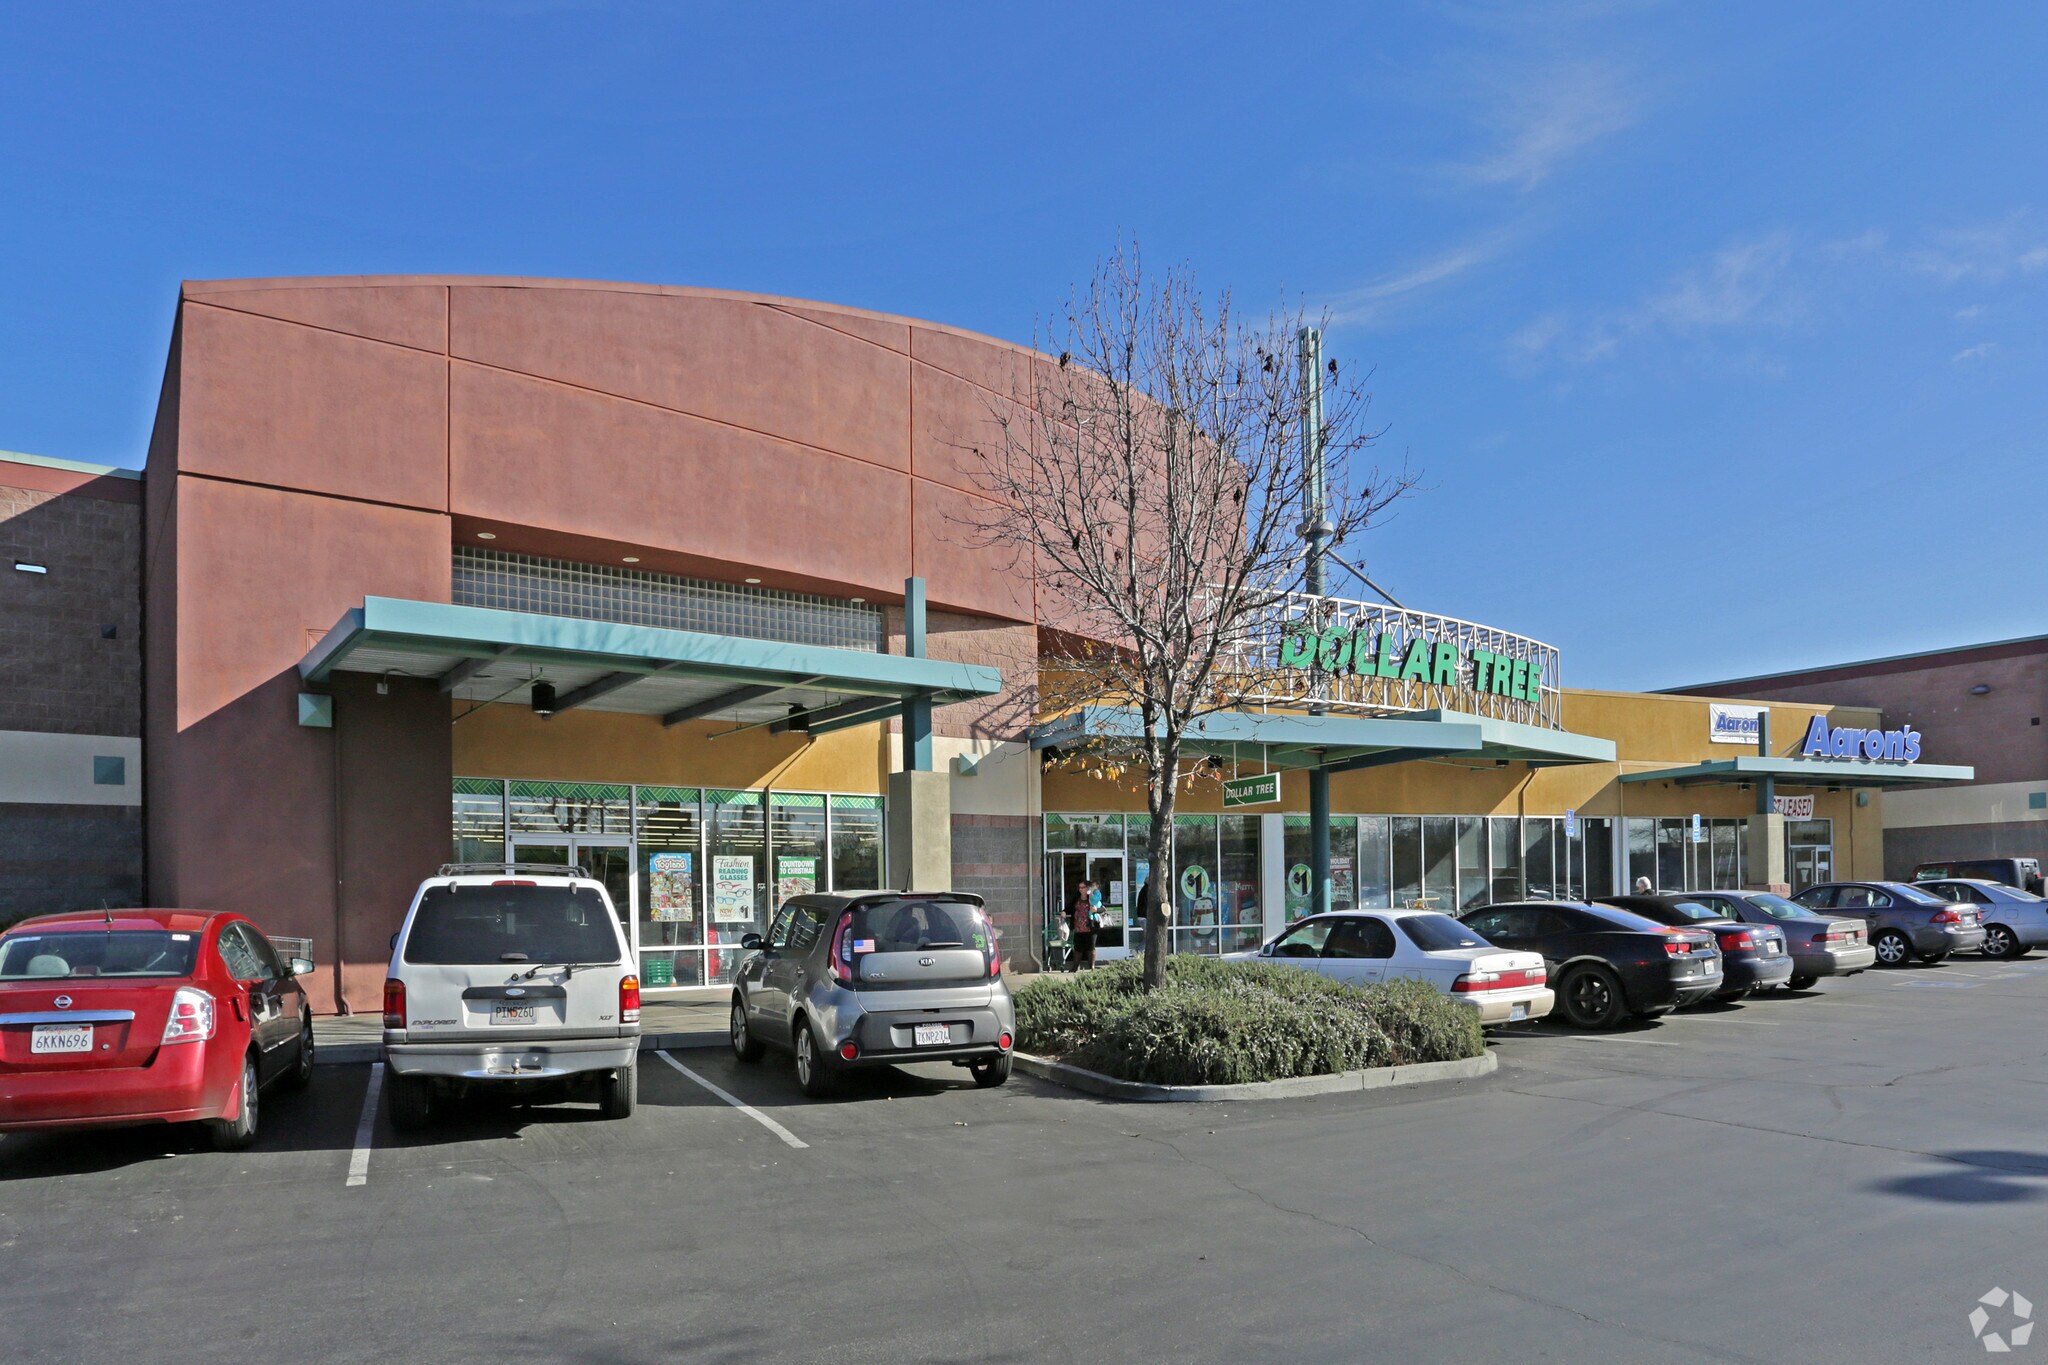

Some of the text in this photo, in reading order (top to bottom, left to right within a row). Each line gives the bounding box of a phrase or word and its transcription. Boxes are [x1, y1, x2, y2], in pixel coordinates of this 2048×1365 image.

[1278, 621, 1542, 703] DOLLAR TREE
[1715, 712, 1759, 733] Aaron
[1801, 714, 1922, 764] Aaron's
[1225, 782, 1275, 799] DOLLAR TREE
[1783, 799, 1812, 816] LEASED
[655, 859, 687, 871] Toyland
[715, 858, 750, 868] Fashion
[780, 860, 815, 868] COUNTDOWN
[780, 867, 815, 875] TO CHRISTMAS
[1186, 872, 1203, 899] $1
[1293, 870, 1308, 897] $1
[740, 905, 749, 919] $1
[36, 1034, 88, 1049] 6KKN696
